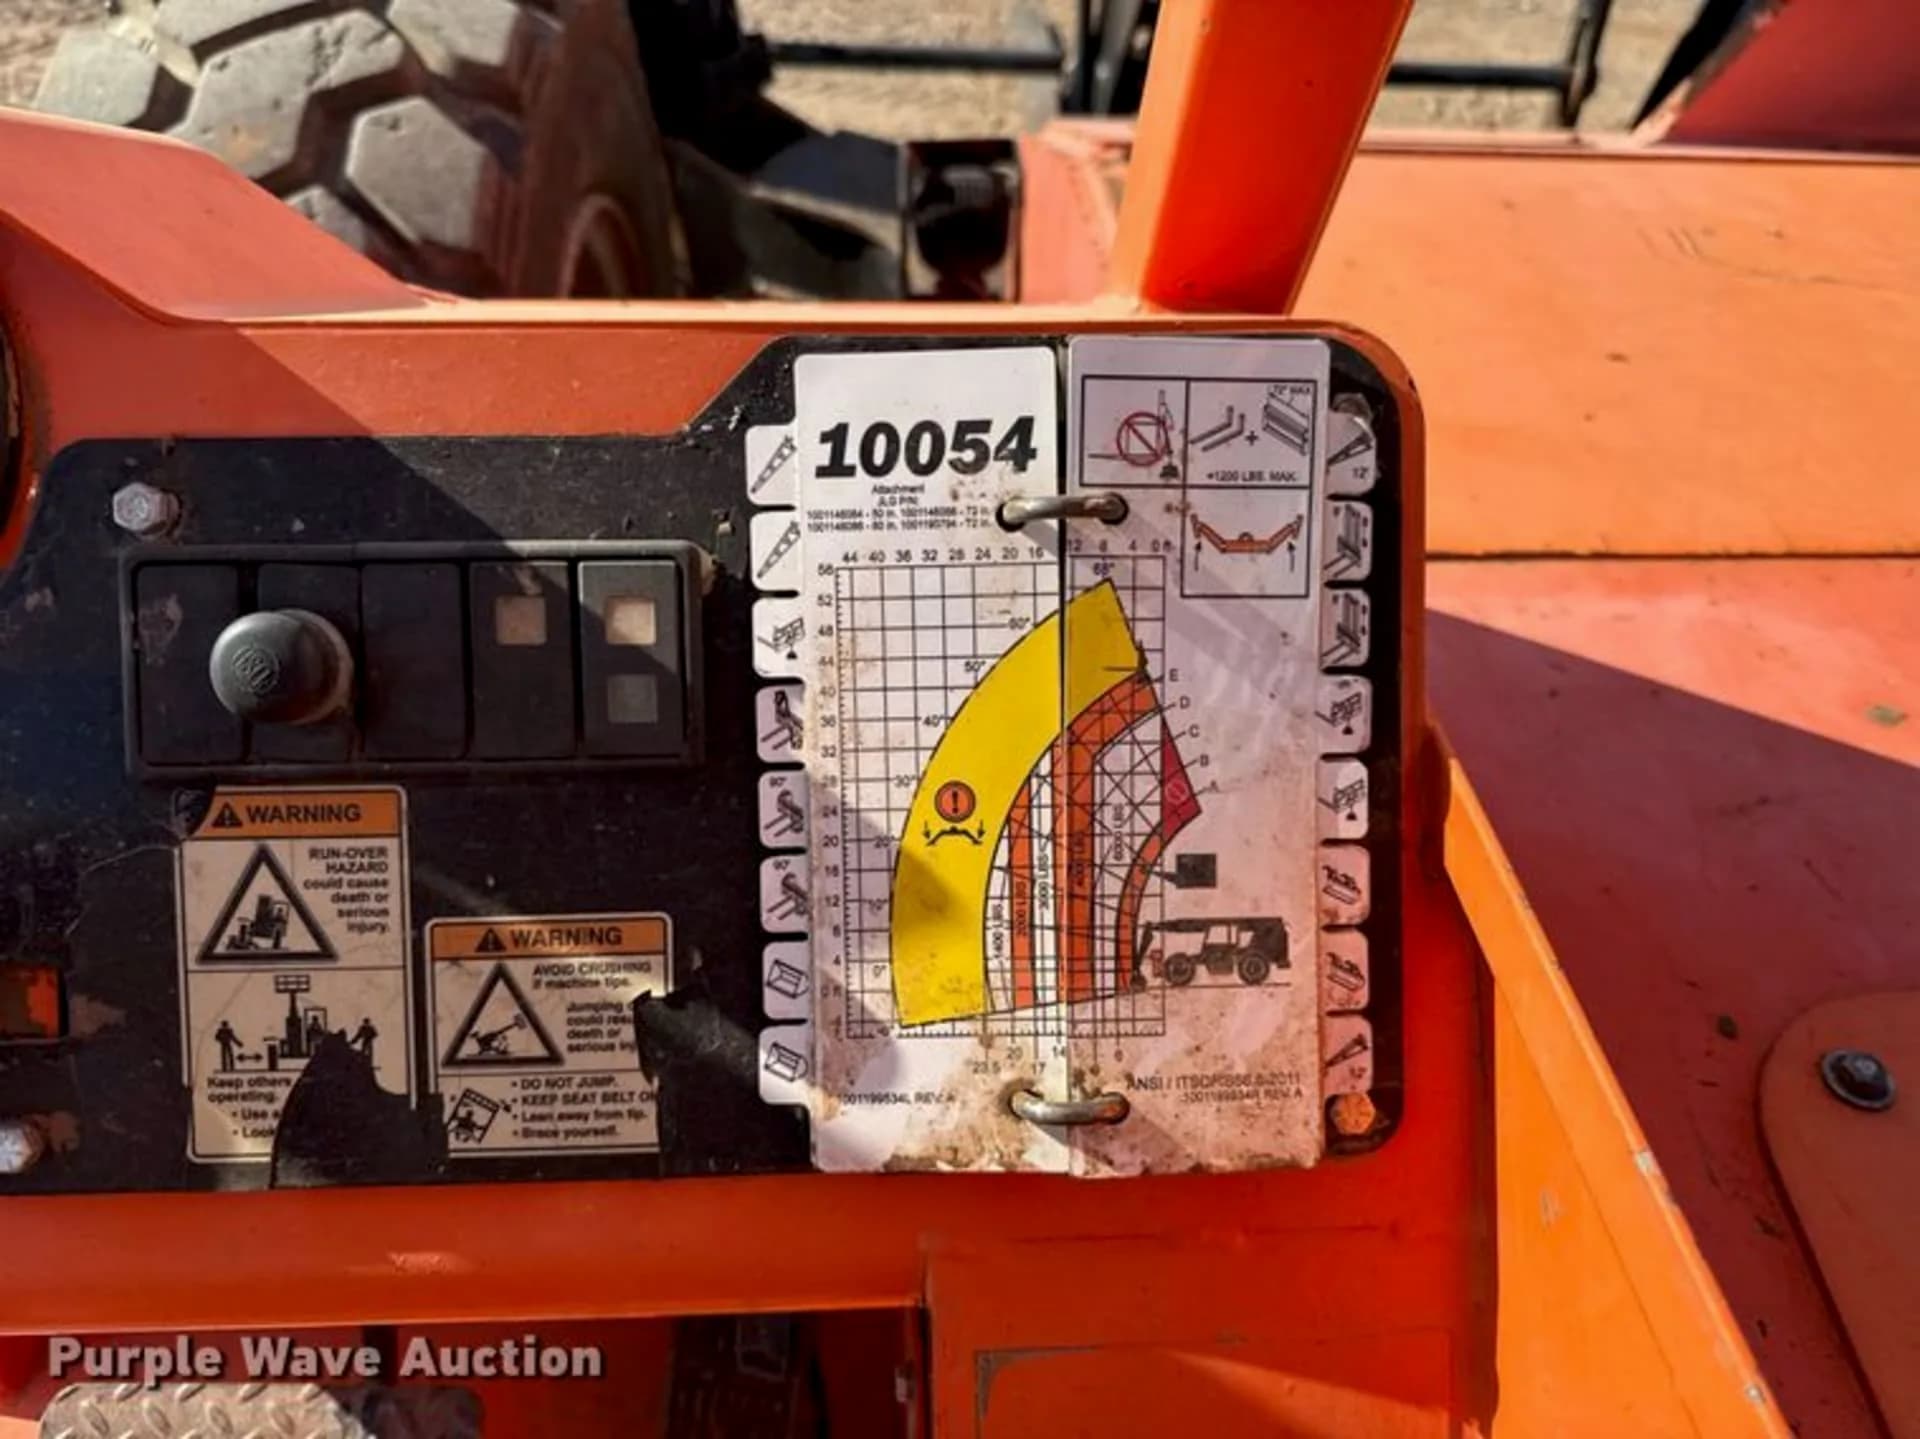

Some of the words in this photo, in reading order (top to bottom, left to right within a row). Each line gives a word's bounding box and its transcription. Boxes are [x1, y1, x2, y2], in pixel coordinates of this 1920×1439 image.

[815, 416, 1037, 479] 10054
[872, 484, 925, 495] Attachment
[842, 551, 858, 562] 44
[868, 551, 885, 562] 40
[921, 550, 938, 562] 32
[975, 549, 991, 561] 24
[1002, 548, 1018, 560] 20
[817, 595, 833, 606] 52
[1169, 668, 1179, 682] E
[1180, 696, 1190, 709] D
[1189, 725, 1199, 738] C
[821, 746, 837, 758] 32
[246, 803, 362, 824] WARNING
[822, 806, 838, 817] 24
[823, 836, 839, 848] 20
[309, 846, 388, 860] RUN-OVER
[326, 862, 388, 874] HAZARD
[303, 877, 342, 890] could
[347, 877, 389, 890] cause
[331, 891, 372, 904] death
[375, 893, 389, 903] or
[825, 896, 840, 908] 12
[337, 906, 389, 919] serious
[510, 927, 622, 948] WARNING
[833, 955, 841, 965] 4
[533, 962, 575, 976] AVOID
[578, 960, 651, 975] CRUSHING
[545, 976, 600, 989] machine
[567, 1001, 623, 1014] Jumping
[567, 1015, 603, 1026] could
[567, 1027, 603, 1040] death
[609, 1028, 622, 1039] or
[567, 1041, 613, 1053] serious
[207, 1077, 243, 1090] Keep
[247, 1076, 292, 1087] others
[521, 1078, 540, 1090] DO
[545, 1077, 573, 1090] NOT
[522, 1094, 556, 1106] KEEP
[562, 1092, 597, 1105] SEAT
[601, 1091, 634, 1104] BELT
[241, 1109, 268, 1121] Use
[522, 1111, 553, 1123] Lean
[557, 1110, 590, 1123] away
[593, 1108, 624, 1120] from
[522, 1126, 559, 1138] Brace
